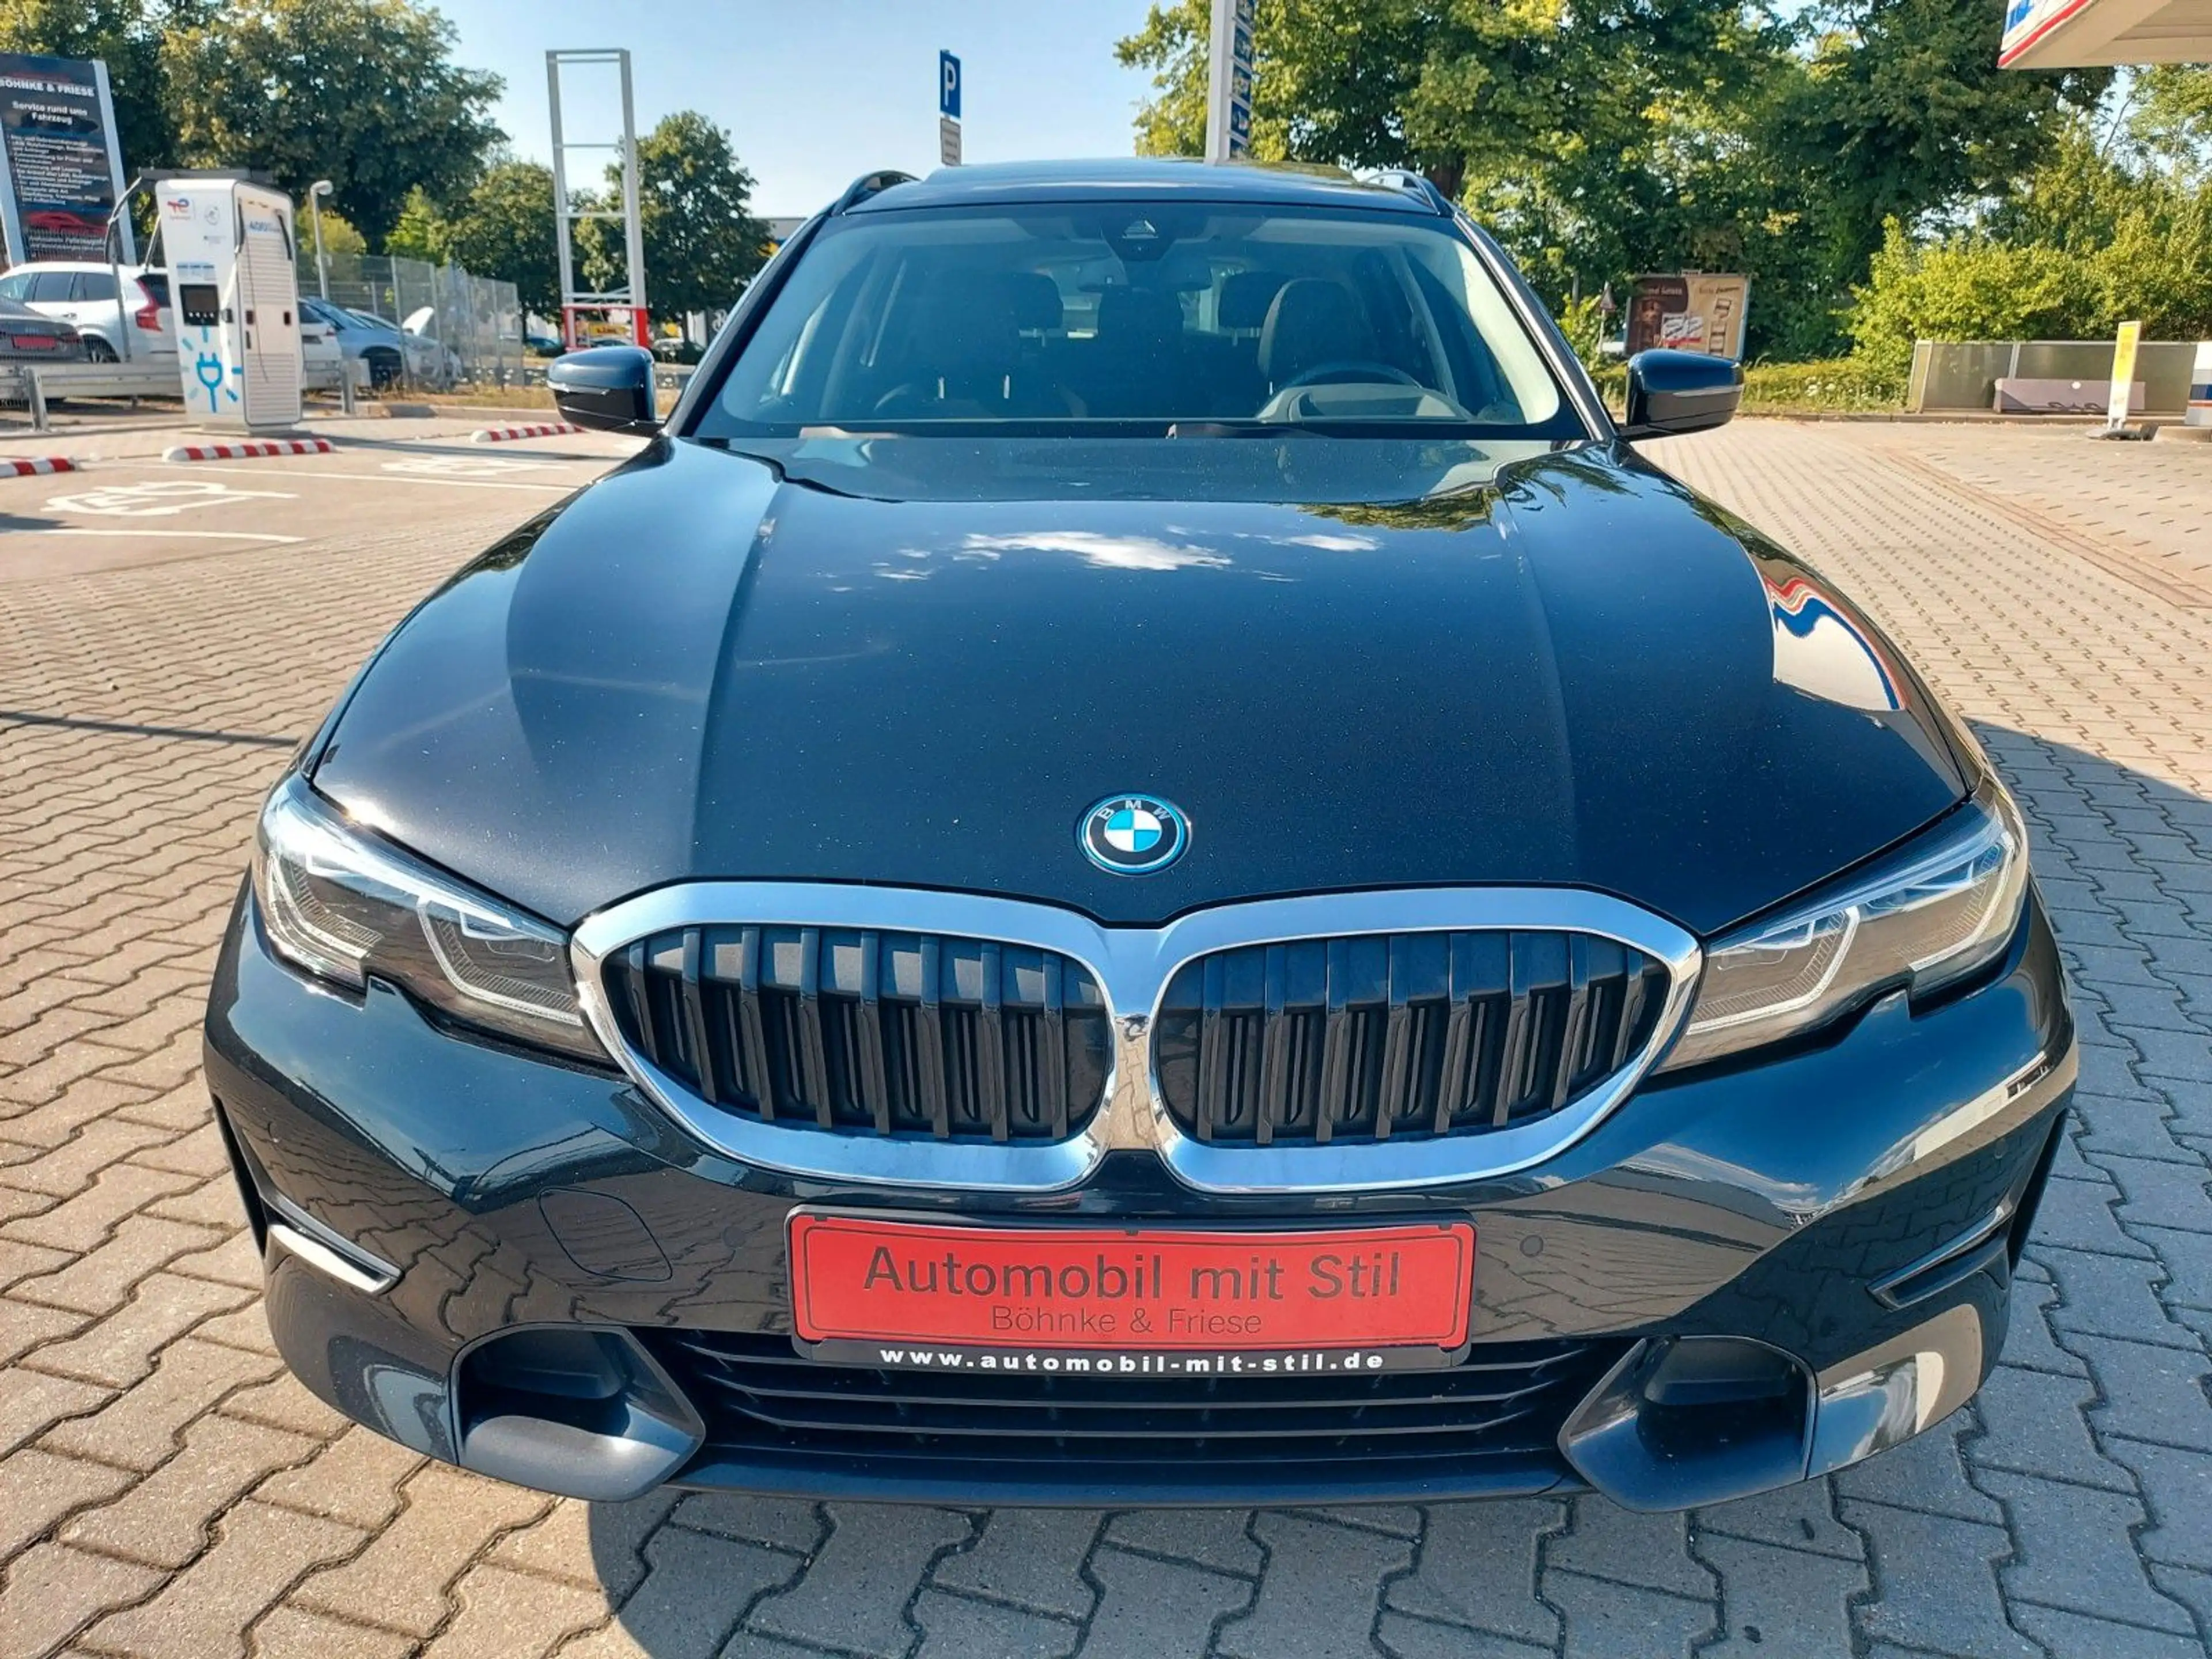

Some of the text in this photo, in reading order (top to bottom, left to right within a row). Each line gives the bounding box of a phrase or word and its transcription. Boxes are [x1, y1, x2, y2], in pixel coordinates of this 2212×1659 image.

[944, 60, 956, 107] P
[12, 100, 45, 112] Service
[47, 105, 67, 114] rund
[1096, 799, 1171, 820] BMW
[863, 1245, 1399, 1300] Automobil mit Stil
[991, 1305, 1262, 1335] Böhnke & Friese
[880, 1349, 1383, 1372] www.automobil-mit-stil.de
